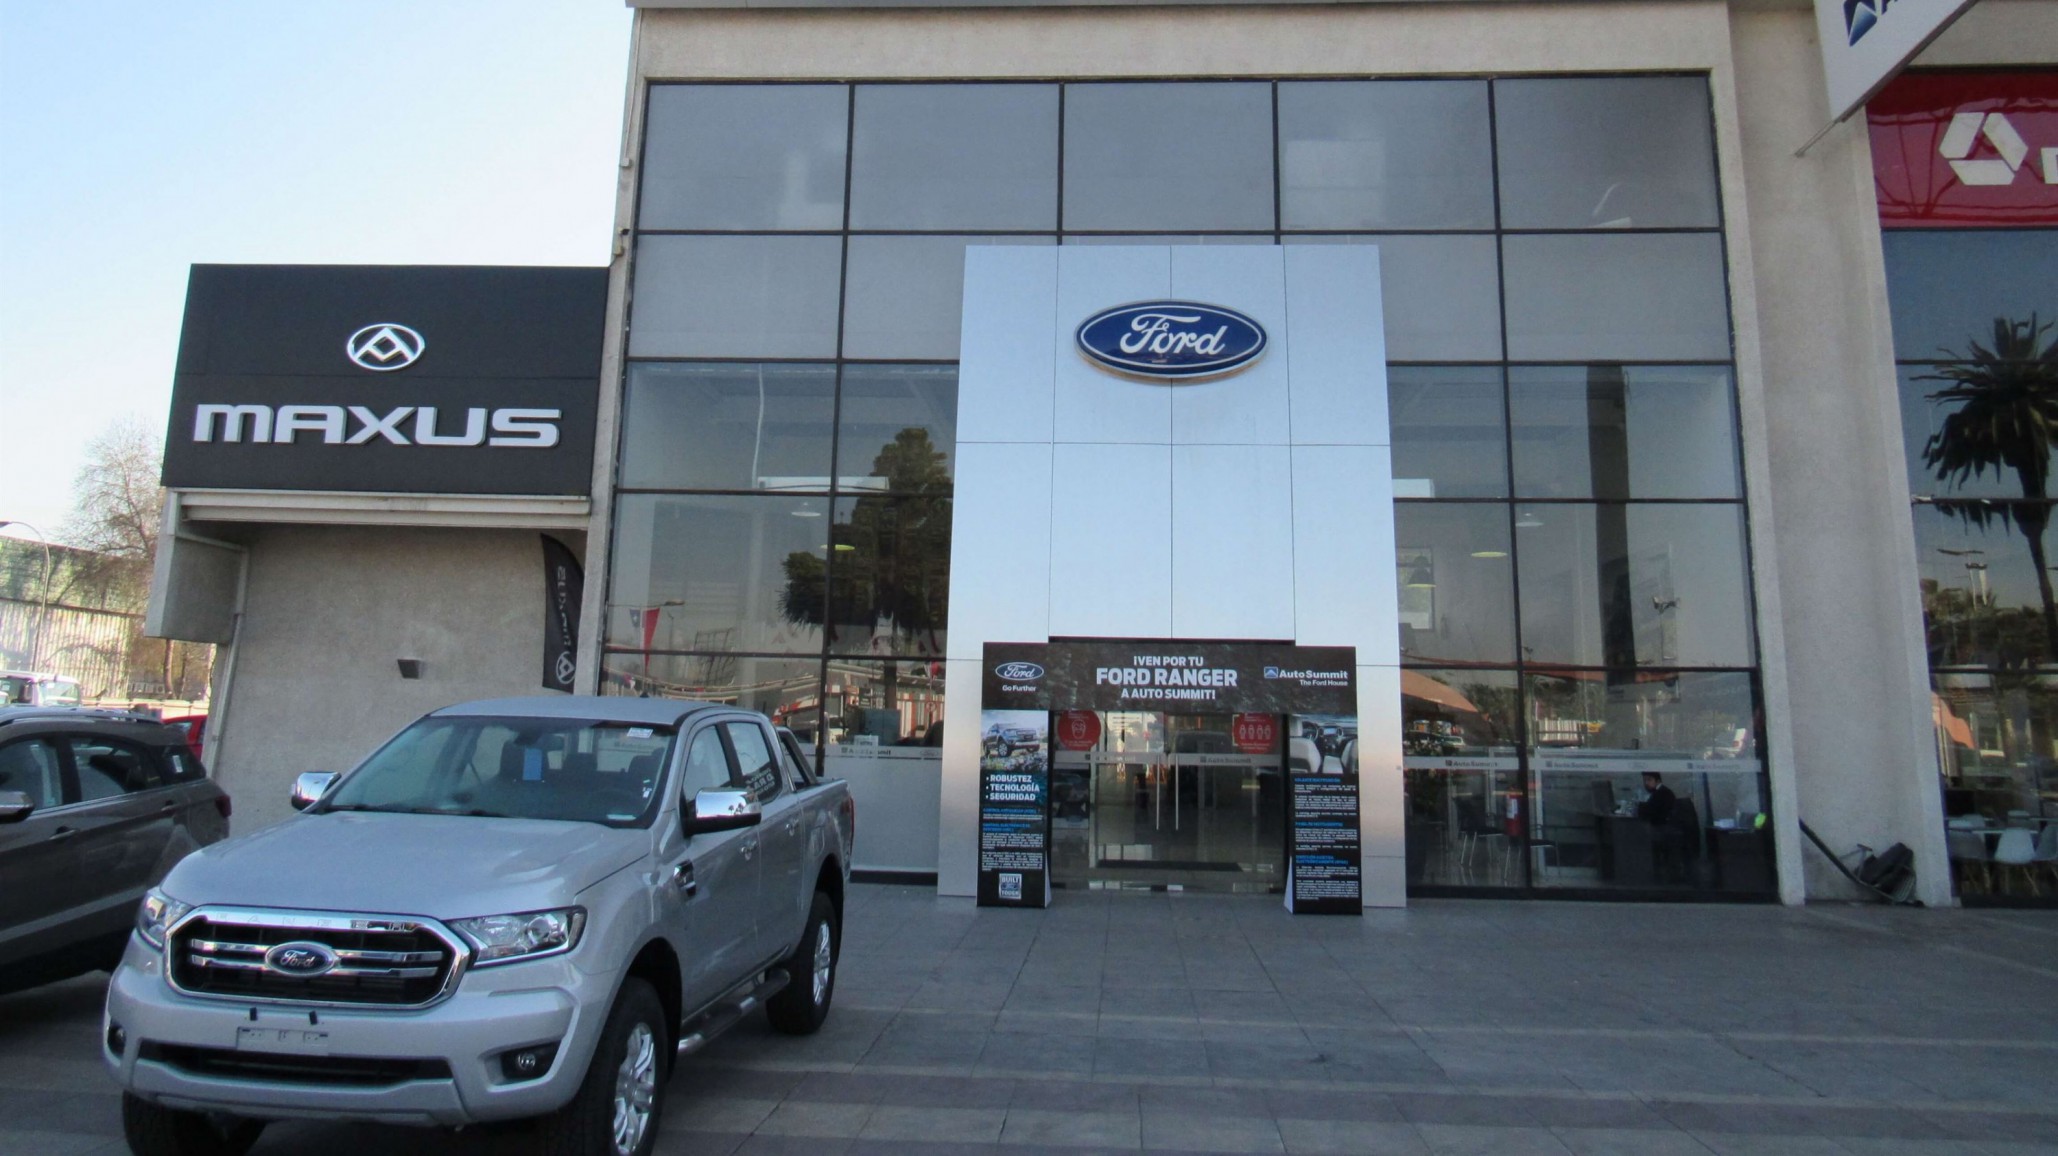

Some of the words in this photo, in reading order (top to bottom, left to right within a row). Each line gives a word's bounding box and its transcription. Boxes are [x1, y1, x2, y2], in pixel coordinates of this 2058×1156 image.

[1120, 313, 1228, 355] Ford
[193, 403, 562, 448] MAXUS
[1133, 656, 1161, 666] ¡VEN
[1163, 656, 1186, 666] POR
[1188, 656, 1204, 666] TU
[1004, 664, 1035, 678] Ford
[1096, 667, 1151, 685] FORD
[1154, 668, 1238, 687] RANGER
[1121, 688, 1130, 698] A
[1131, 688, 1163, 699] AUTO
[1164, 689, 1216, 700] SUMMIT!
[990, 774, 1032, 783] ROBUSTEZ
[990, 782, 1040, 792] TECNOLOGÍA
[989, 792, 1036, 801] SEGURIDAD
[280, 949, 316, 967] Ford
